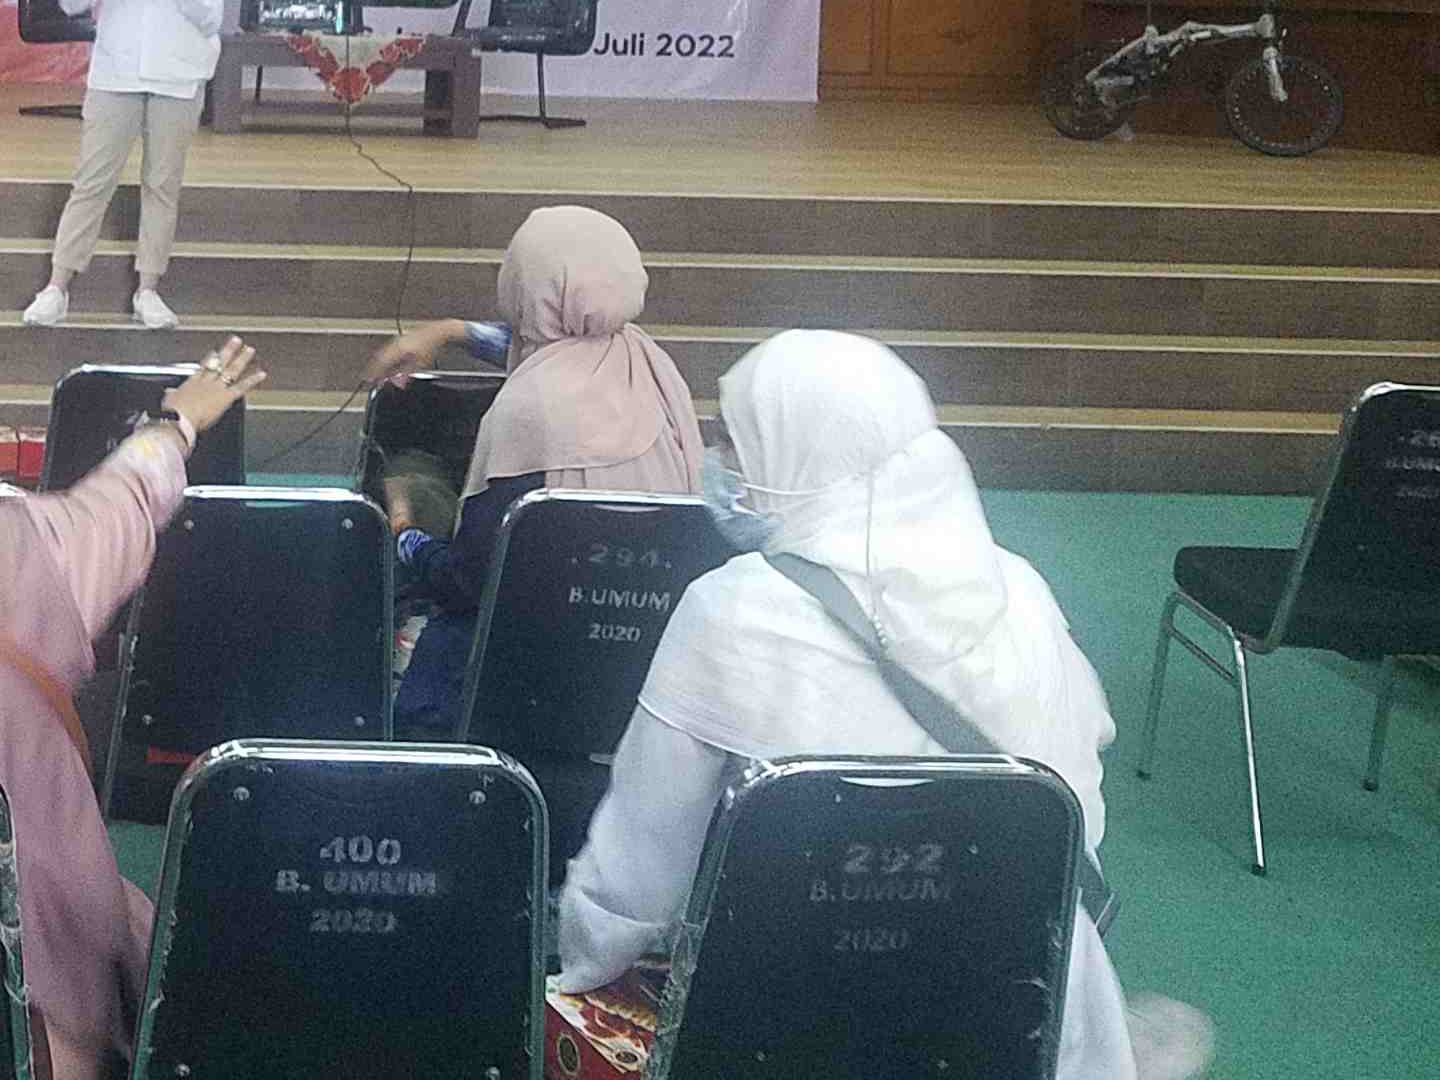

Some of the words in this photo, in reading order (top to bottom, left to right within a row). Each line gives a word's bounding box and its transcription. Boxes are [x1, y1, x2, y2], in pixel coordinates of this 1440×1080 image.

[593, 32, 645, 57] Juli
[655, 33, 736, 58] 2022
[588, 623, 641, 642] 2020
[319, 835, 402, 865] 400
[310, 908, 397, 933] 2020
